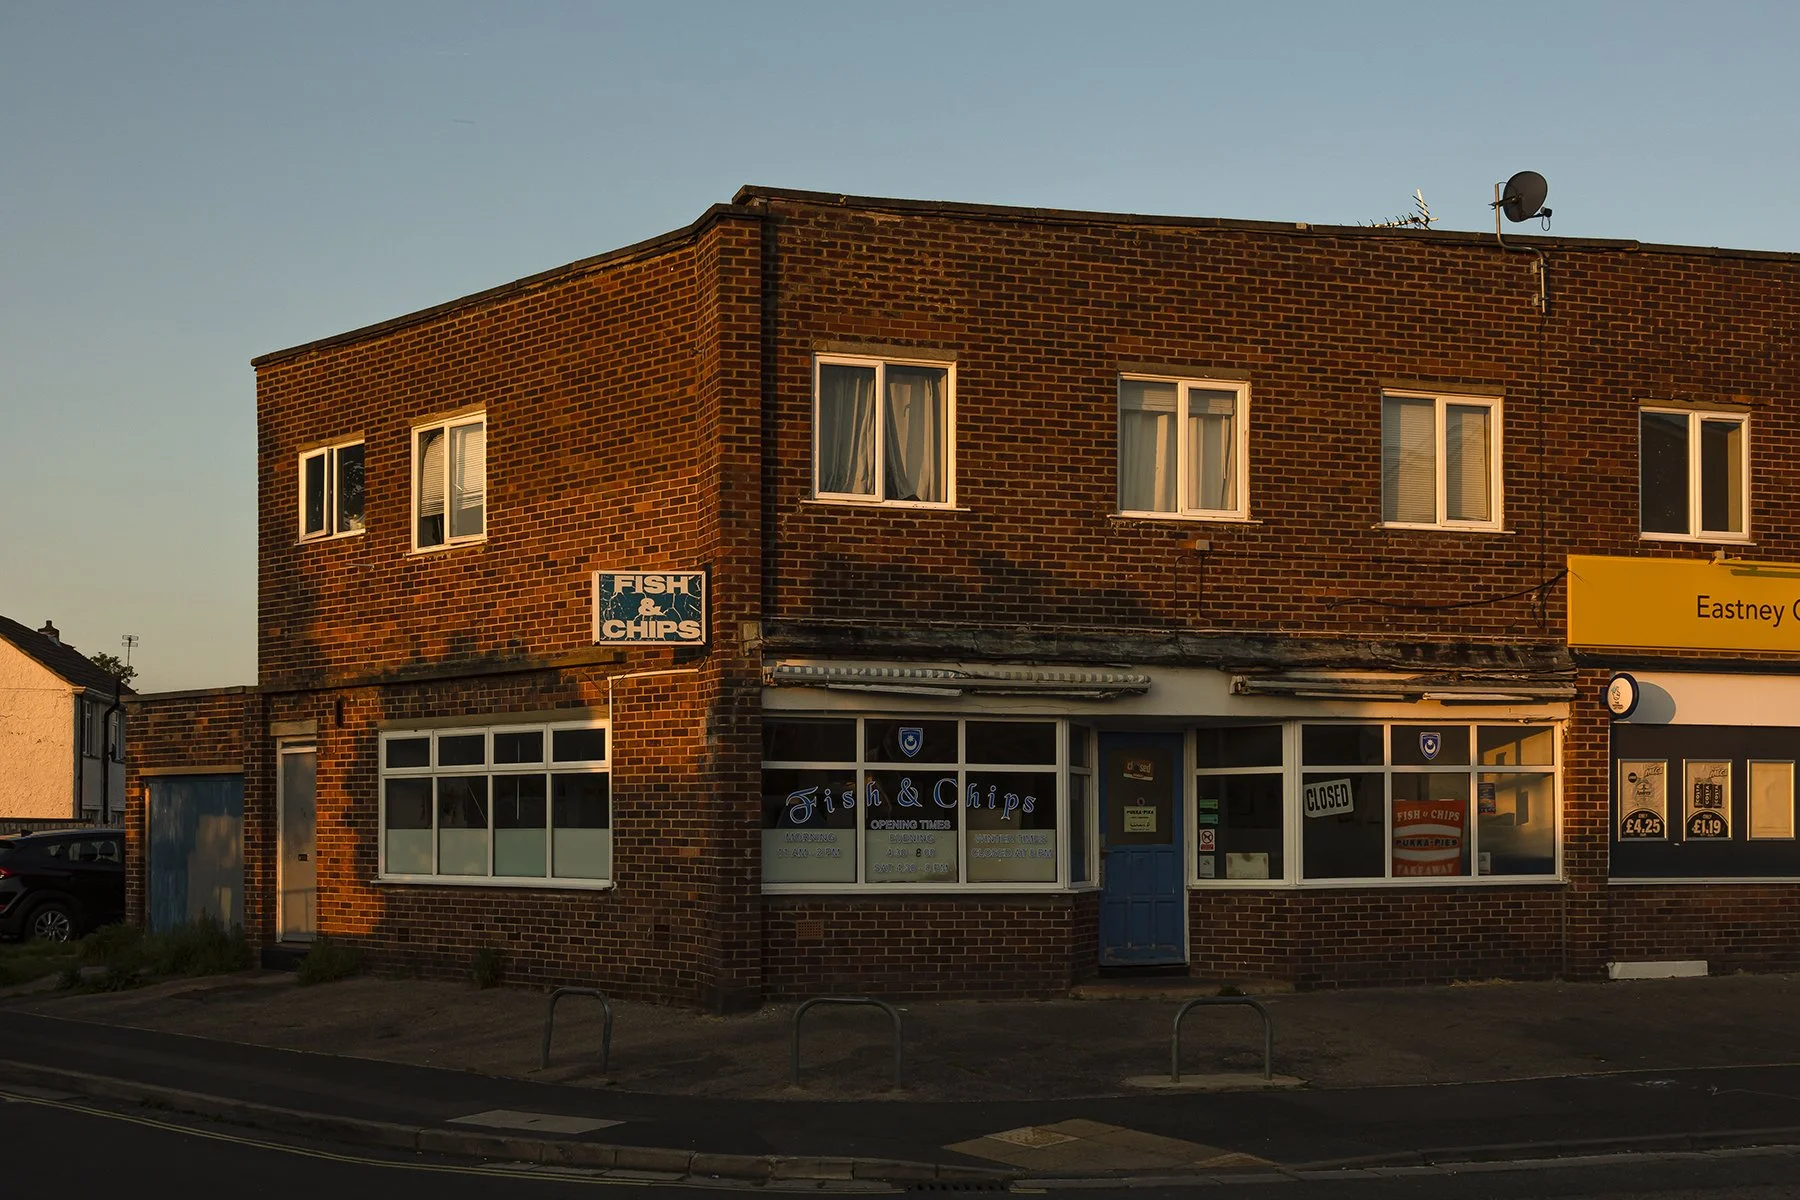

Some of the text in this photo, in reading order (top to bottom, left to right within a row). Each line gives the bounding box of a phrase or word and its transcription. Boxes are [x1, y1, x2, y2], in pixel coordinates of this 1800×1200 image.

[614, 575, 689, 594] FISH
[638, 597, 667, 617] &
[1697, 595, 1785, 628] Eastney
[602, 619, 701, 639] CHIPS
[786, 777, 1037, 824] Fish & Chips
[1306, 783, 1349, 812] CLOSED
[1396, 809, 1420, 822] FISH
[1430, 808, 1460, 822] CHIPS
[870, 819, 951, 830] OPENING TIMES
[1625, 818, 1661, 834] £4.25
[1692, 818, 1722, 834] £1.19
[784, 832, 838, 843] MORNING
[888, 832, 936, 844] EVENING
[1396, 863, 1454, 875] TAKEAWAY
